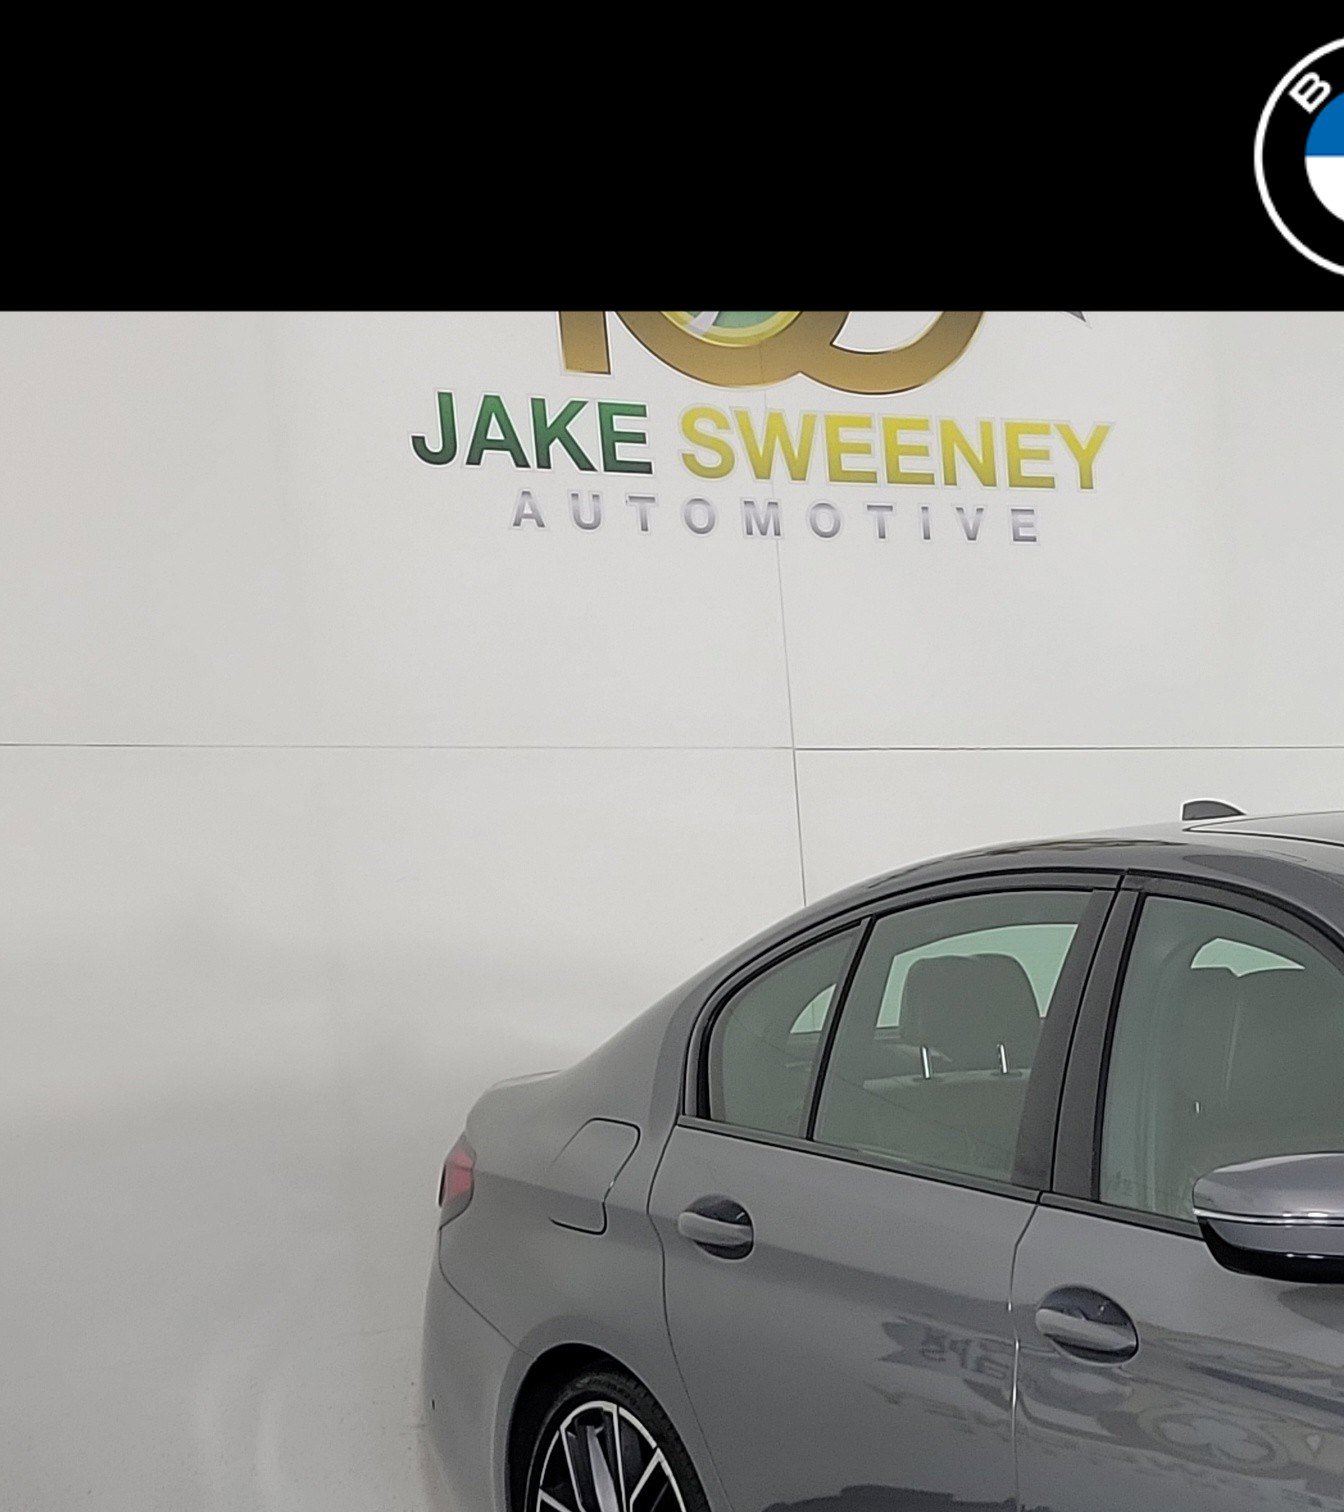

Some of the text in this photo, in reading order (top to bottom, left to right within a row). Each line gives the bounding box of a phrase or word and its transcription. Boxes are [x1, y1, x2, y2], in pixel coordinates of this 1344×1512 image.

[410, 390, 1113, 491] JAKE SWEENEY
[512, 489, 1039, 543] AUTOMOTIVE
